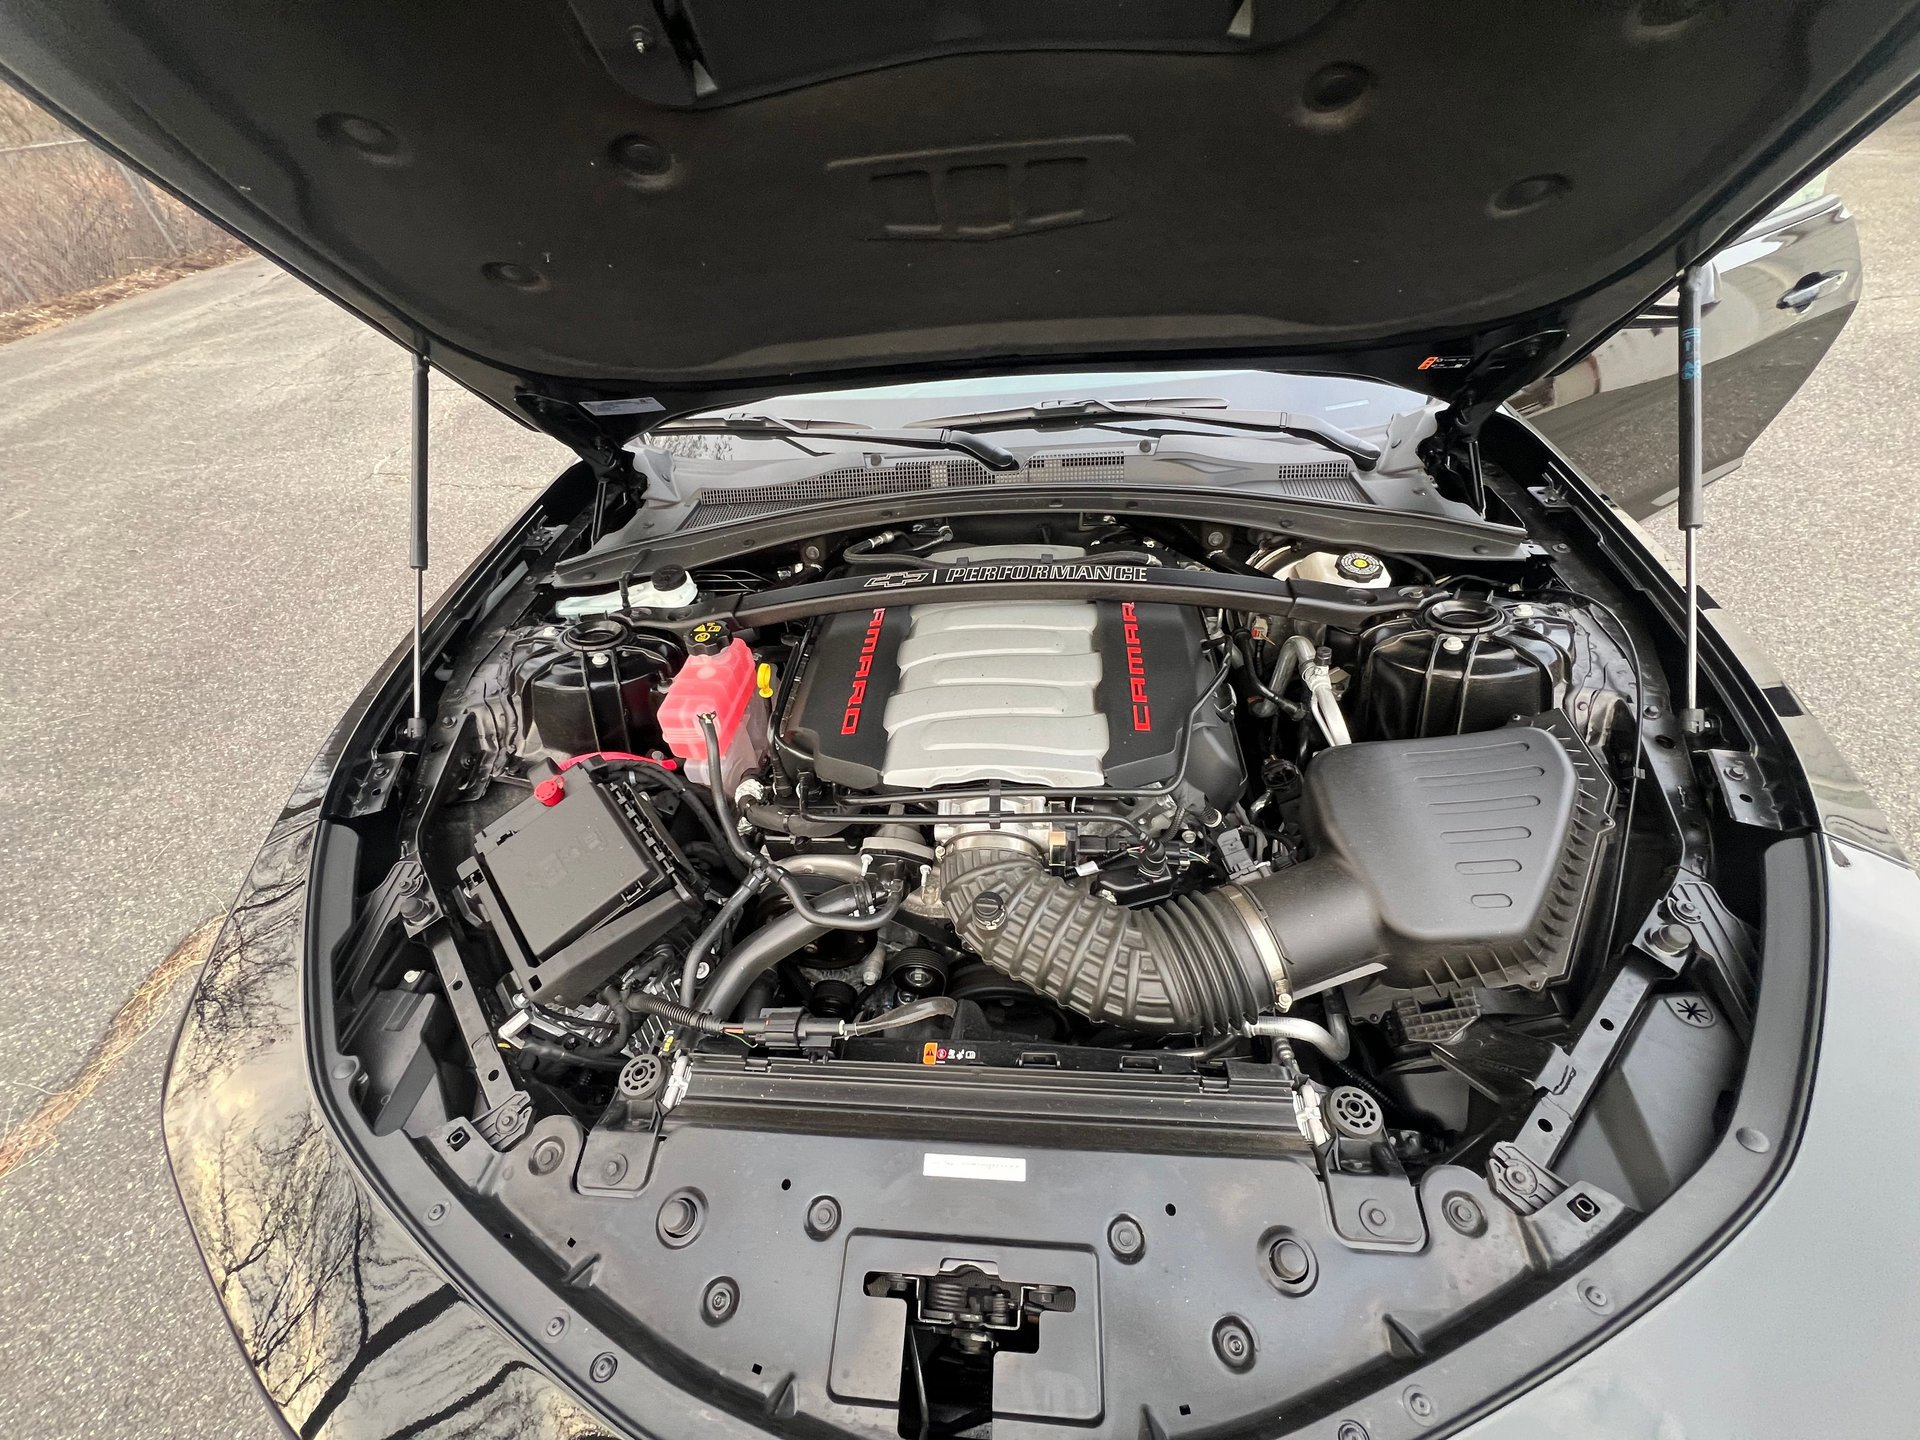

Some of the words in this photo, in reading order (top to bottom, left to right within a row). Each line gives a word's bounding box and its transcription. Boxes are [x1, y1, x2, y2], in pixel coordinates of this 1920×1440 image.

[945, 565, 1148, 583] PERFORMANCE
[840, 607, 886, 735] AMARO
[1121, 601, 1152, 732] CAMAR
